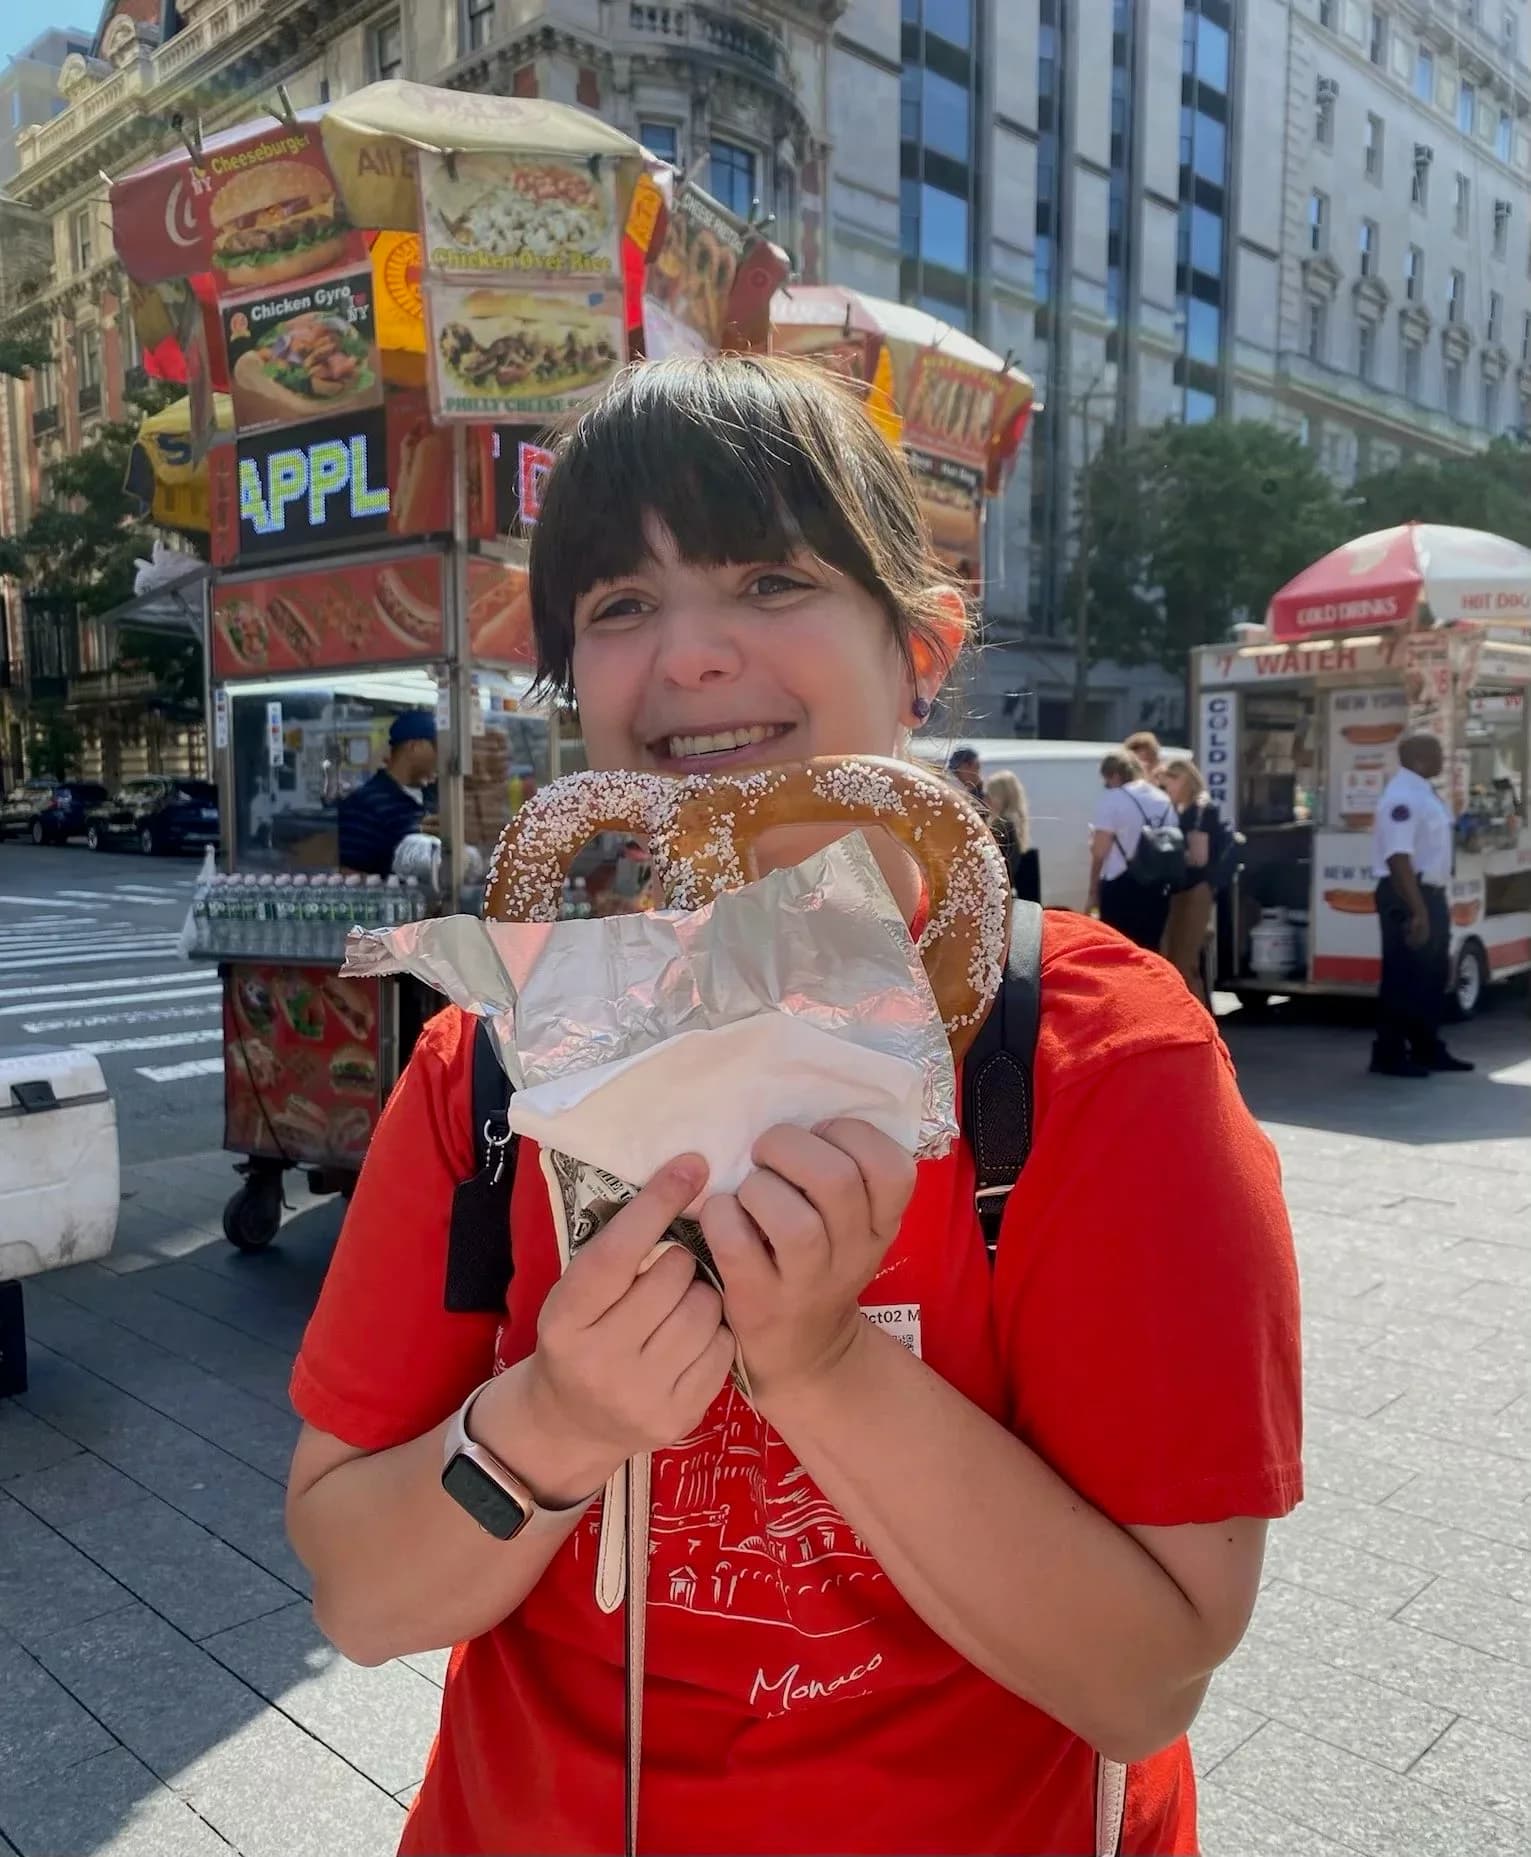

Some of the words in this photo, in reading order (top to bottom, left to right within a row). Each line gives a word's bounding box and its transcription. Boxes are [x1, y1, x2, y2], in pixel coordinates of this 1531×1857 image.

[210, 133, 311, 175] Cheeseburger
[432, 248, 515, 269] Chicken
[520, 249, 562, 272] Over
[569, 251, 612, 271] Rice
[251, 294, 312, 321] Chicken
[314, 285, 351, 307] Gyro
[1296, 604, 1337, 625] COLD
[1339, 596, 1398, 619] DRINKS
[1255, 648, 1356, 675] WATER
[1208, 698, 1229, 764] COLD
[749, 1652, 883, 1711] Monaco
